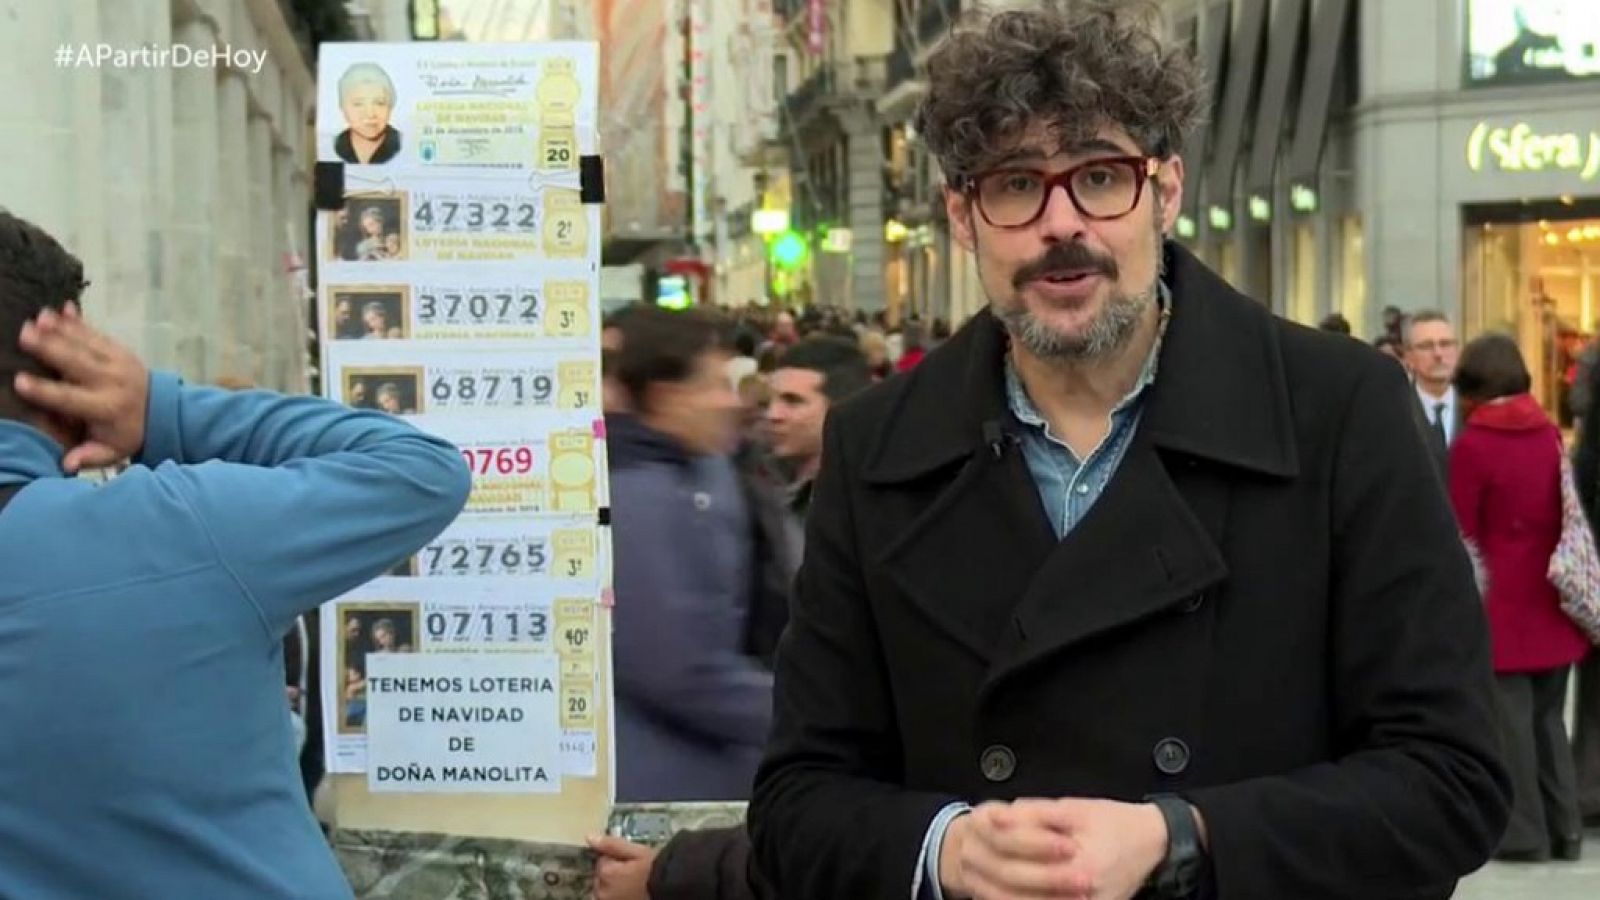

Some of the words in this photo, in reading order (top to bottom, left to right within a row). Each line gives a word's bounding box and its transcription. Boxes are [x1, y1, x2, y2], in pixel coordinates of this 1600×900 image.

[546, 149, 570, 162] 20
[414, 202, 536, 227] 47322
[418, 294, 538, 318] 37072
[432, 375, 552, 400] 68719
[427, 543, 545, 570] 72765
[427, 612, 547, 637] 07113
[368, 677, 463, 693] TENEMOS
[469, 677, 554, 693] LOTERIA
[567, 697, 587, 712] 20
[399, 707, 425, 723] DE
[431, 707, 524, 723] NAVIDAD
[448, 737, 476, 752] DE
[376, 762, 436, 782] DOÑA
[441, 766, 548, 782] MANOLITA
